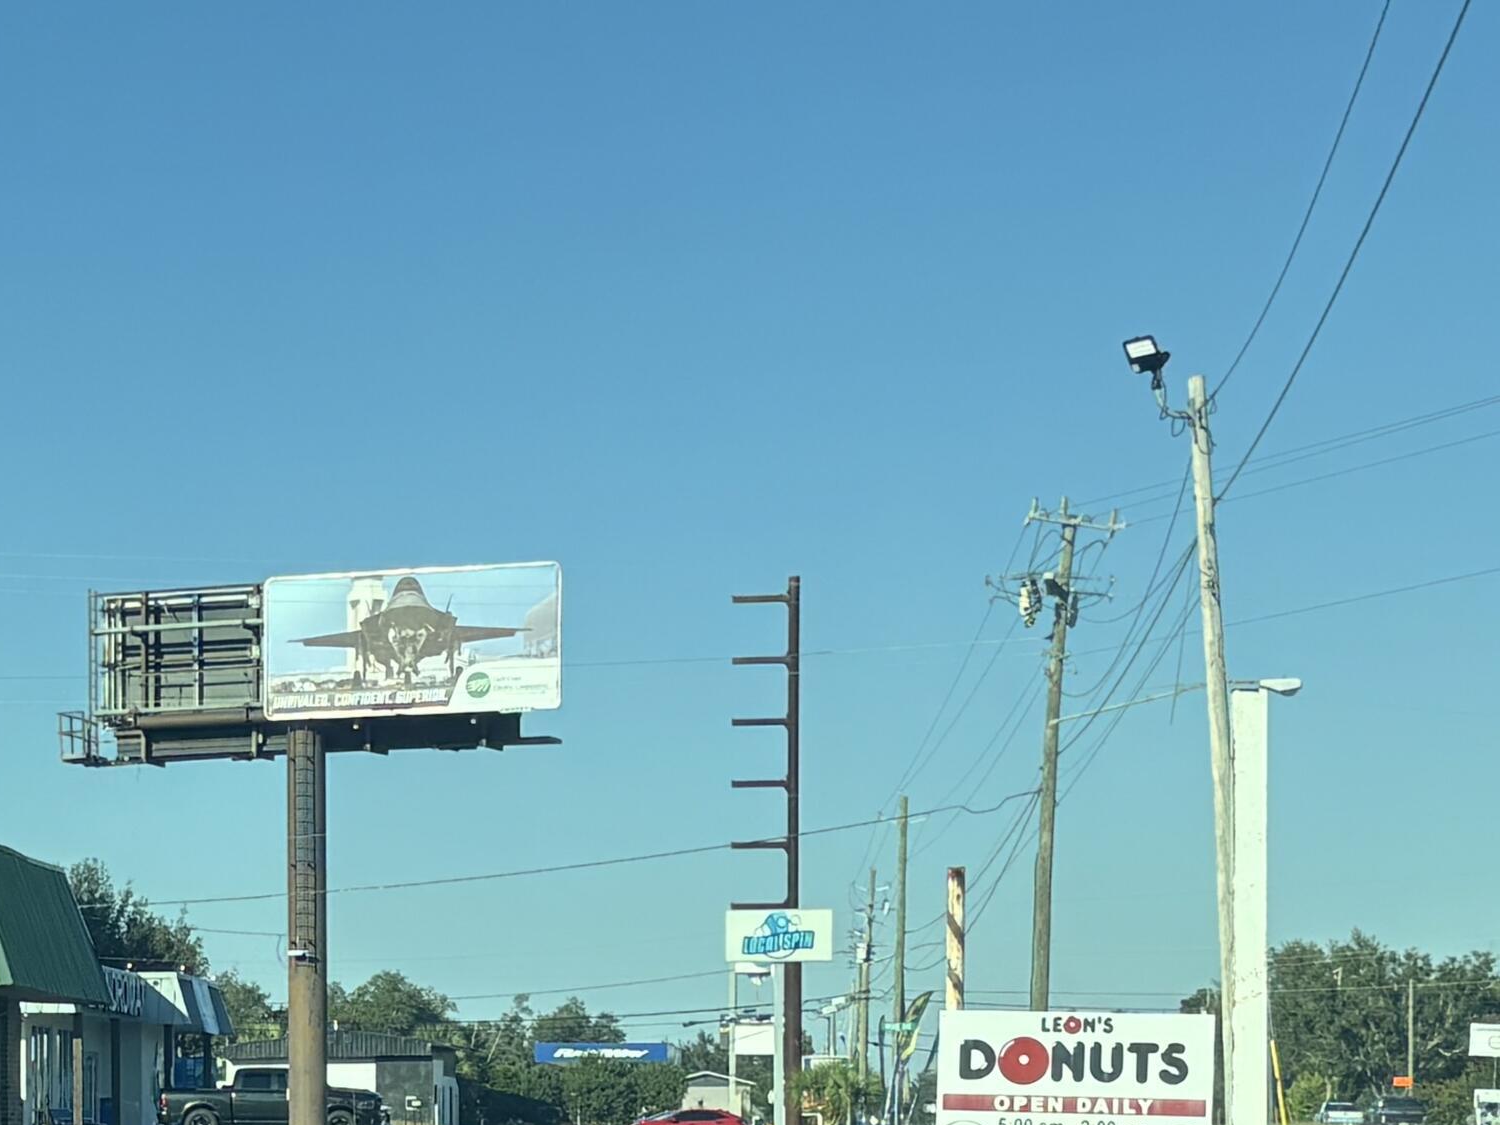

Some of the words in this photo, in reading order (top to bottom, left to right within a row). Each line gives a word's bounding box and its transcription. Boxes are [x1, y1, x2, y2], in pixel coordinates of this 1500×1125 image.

[742, 934, 780, 954] LOCAL
[1041, 1016, 1113, 1035] LEON'S
[959, 1036, 1189, 1085] DONUTS
[993, 1095, 1063, 1113] OPEN
[1076, 1097, 1154, 1115] DAILY
